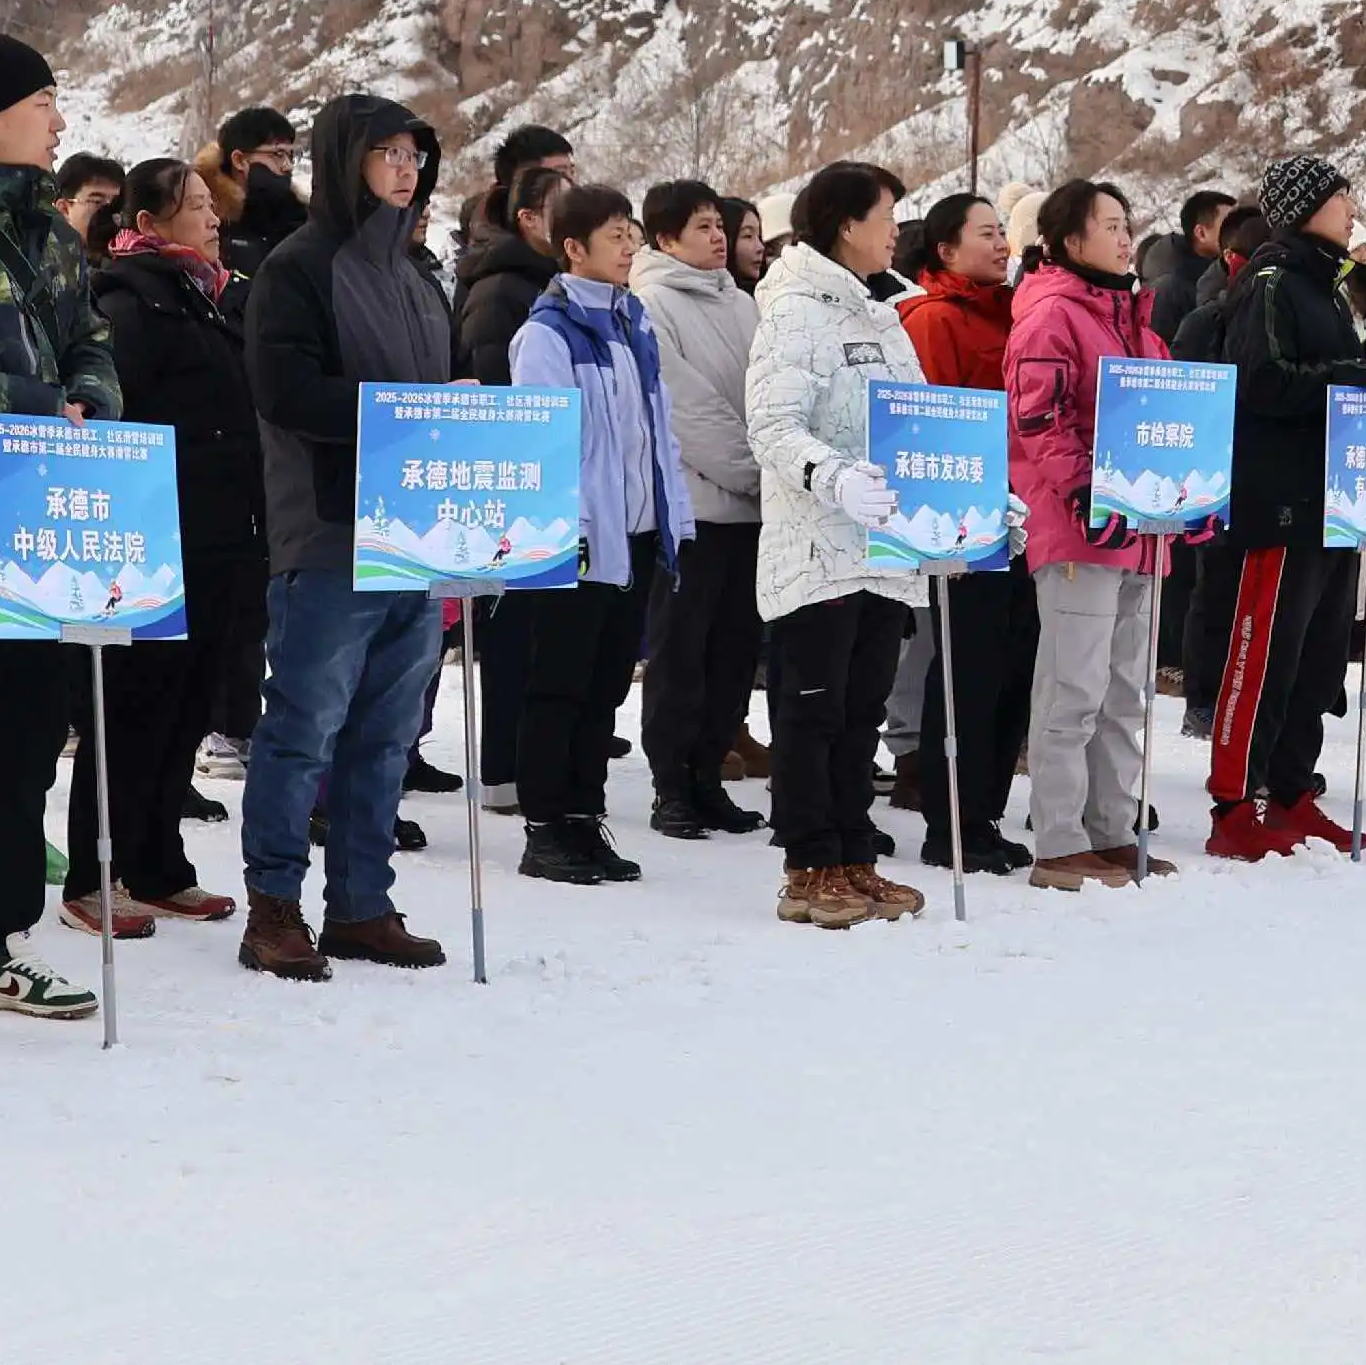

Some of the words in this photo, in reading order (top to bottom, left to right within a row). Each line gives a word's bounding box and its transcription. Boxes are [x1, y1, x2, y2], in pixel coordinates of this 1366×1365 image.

[1136, 421, 1194, 448] 市检察院
[401, 459, 541, 492] 承德地震监测
[894, 450, 984, 484] 承德市发改委
[45, 486, 111, 521] 承德市
[437, 498, 506, 529] 中心站
[13, 528, 147, 564] 中级人民法院
